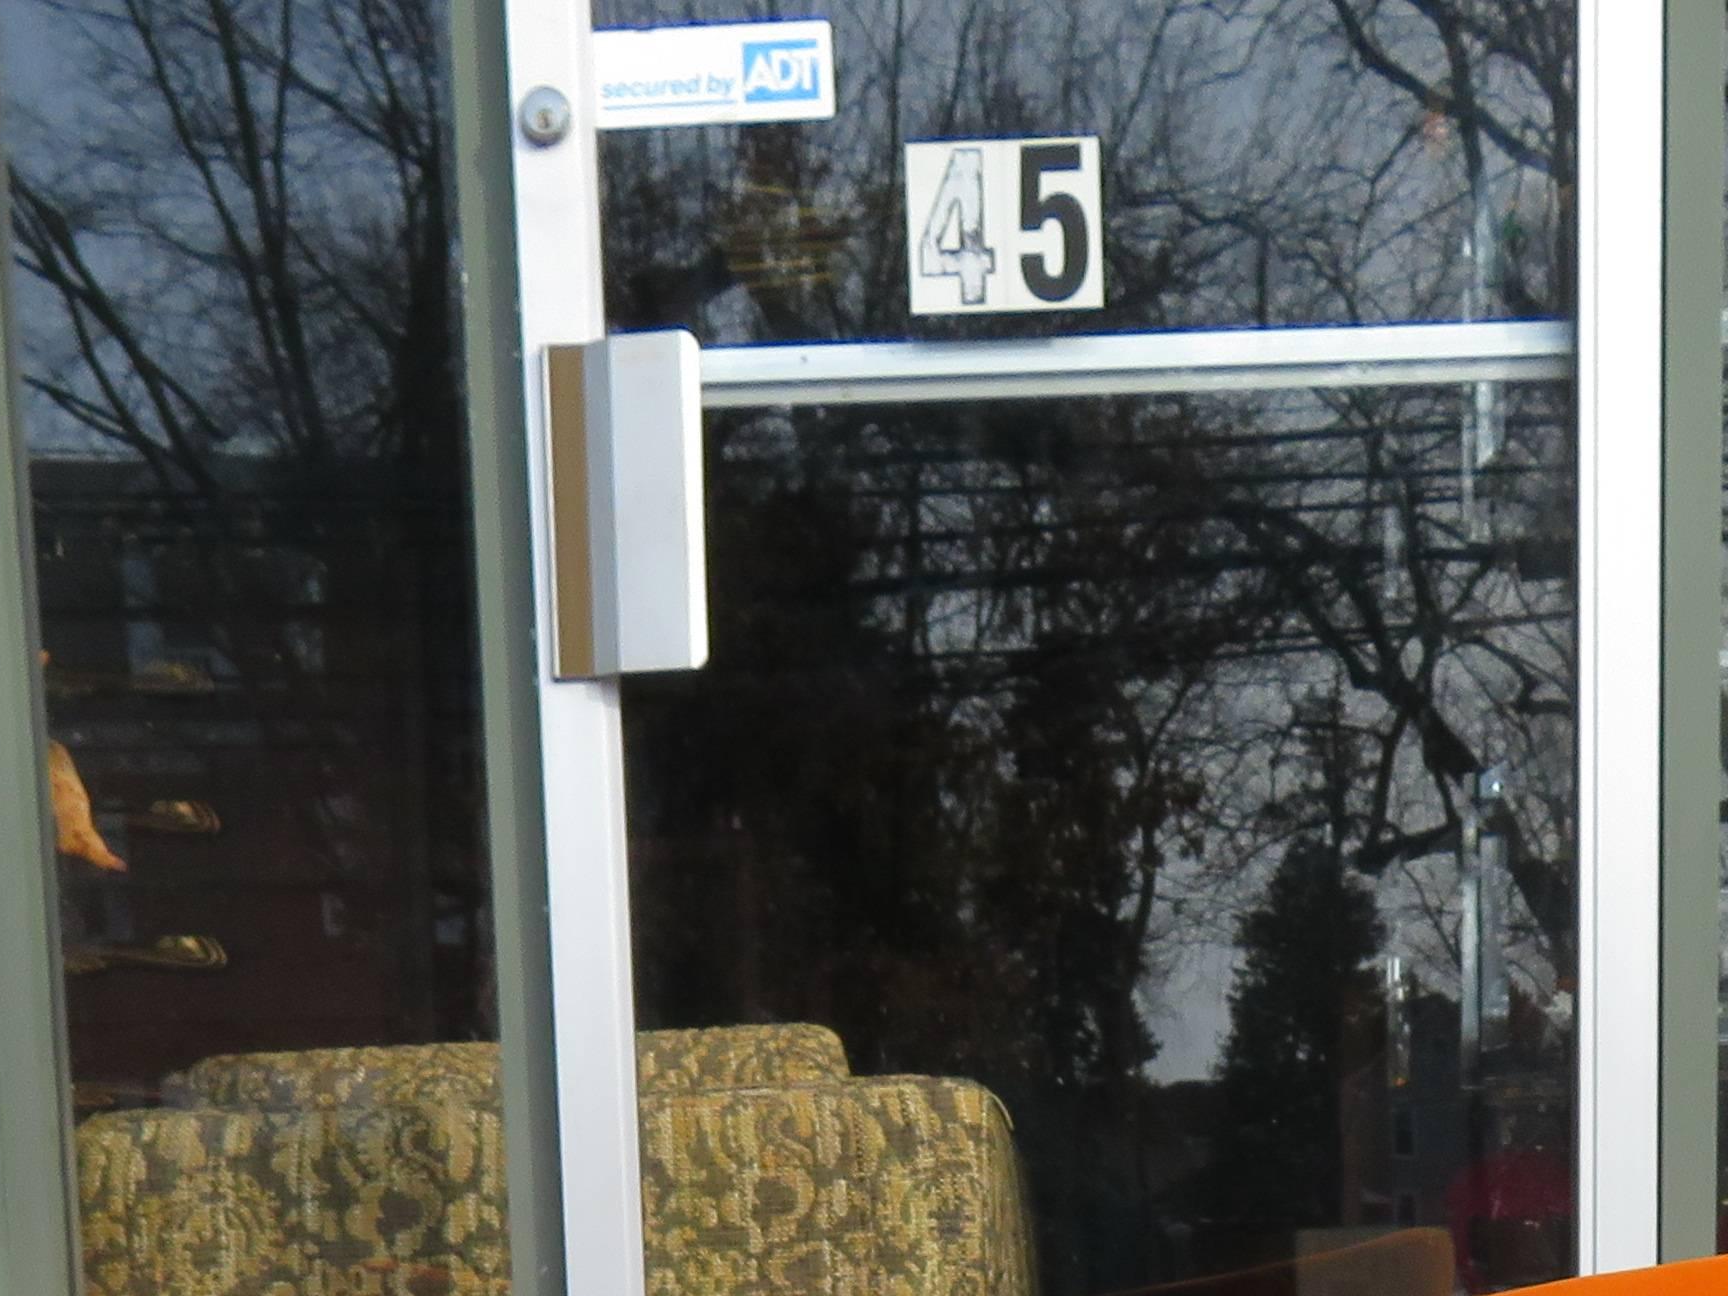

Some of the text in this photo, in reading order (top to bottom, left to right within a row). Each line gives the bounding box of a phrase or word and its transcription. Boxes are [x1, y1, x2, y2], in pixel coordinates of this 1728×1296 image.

[600, 46, 820, 98] secured by ADT
[920, 144, 1089, 305] 45
